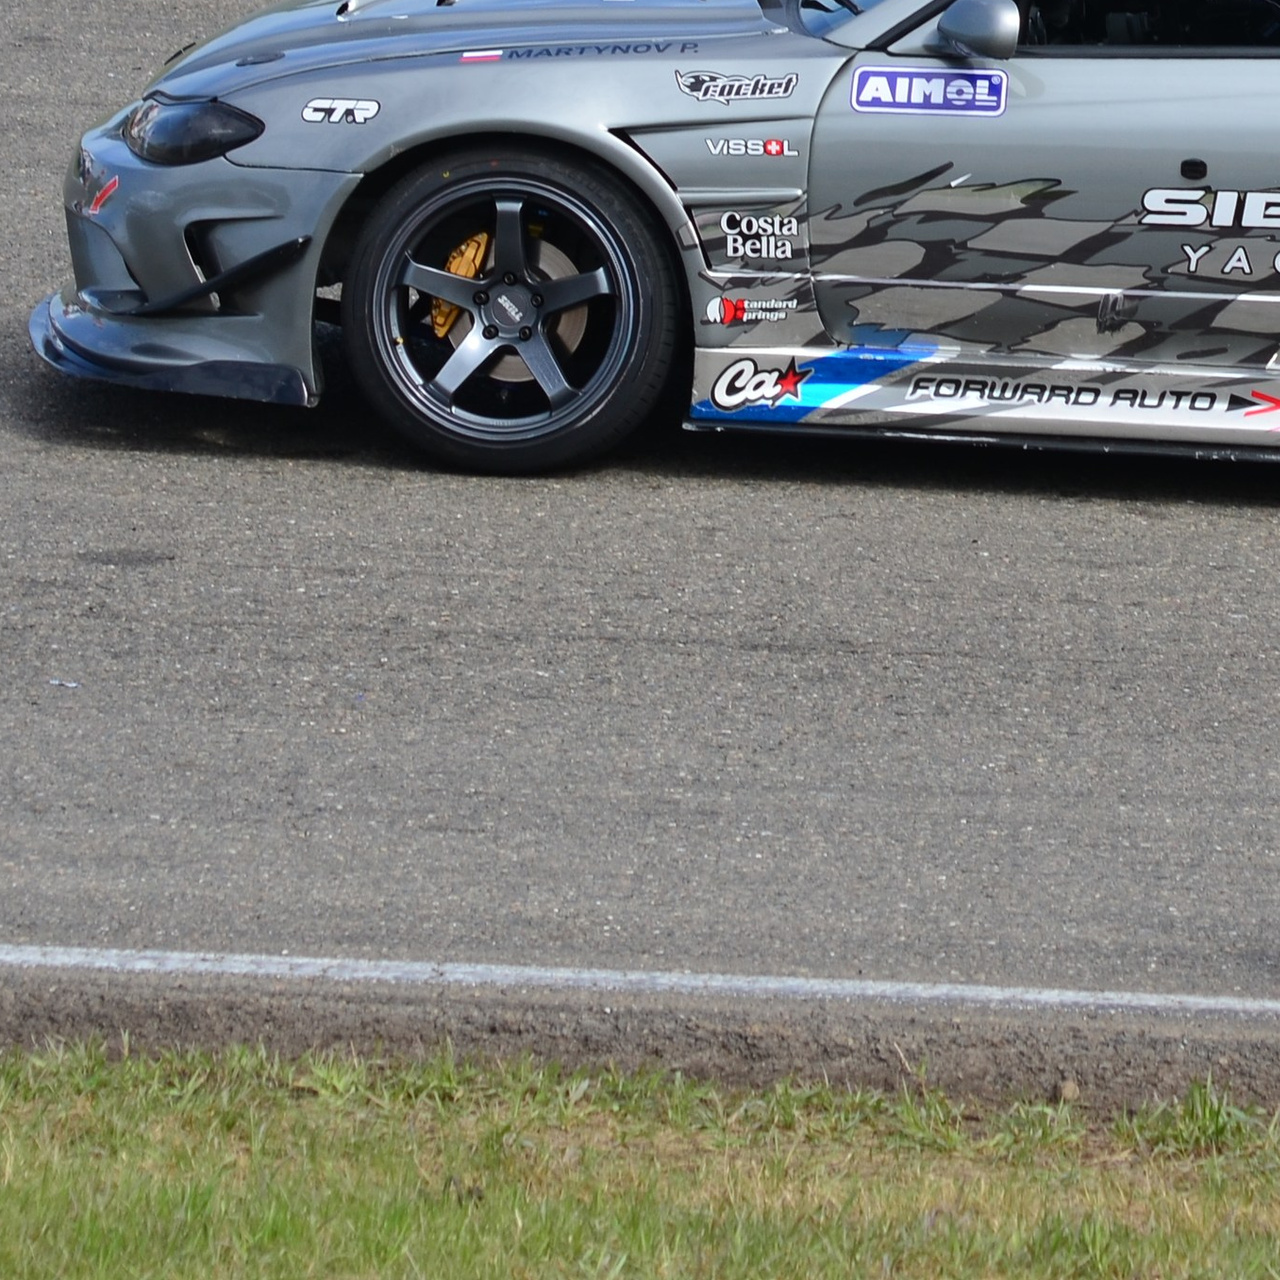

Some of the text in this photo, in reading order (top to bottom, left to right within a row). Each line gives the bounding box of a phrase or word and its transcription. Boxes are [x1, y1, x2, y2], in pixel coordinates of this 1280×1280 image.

[507, 42, 672, 60] MARTYNOV
[858, 76, 998, 106] AIMOL
[720, 211, 798, 236] Costa
[726, 235, 793, 259] Bella
[910, 376, 1217, 411] FORWARD AUTO
